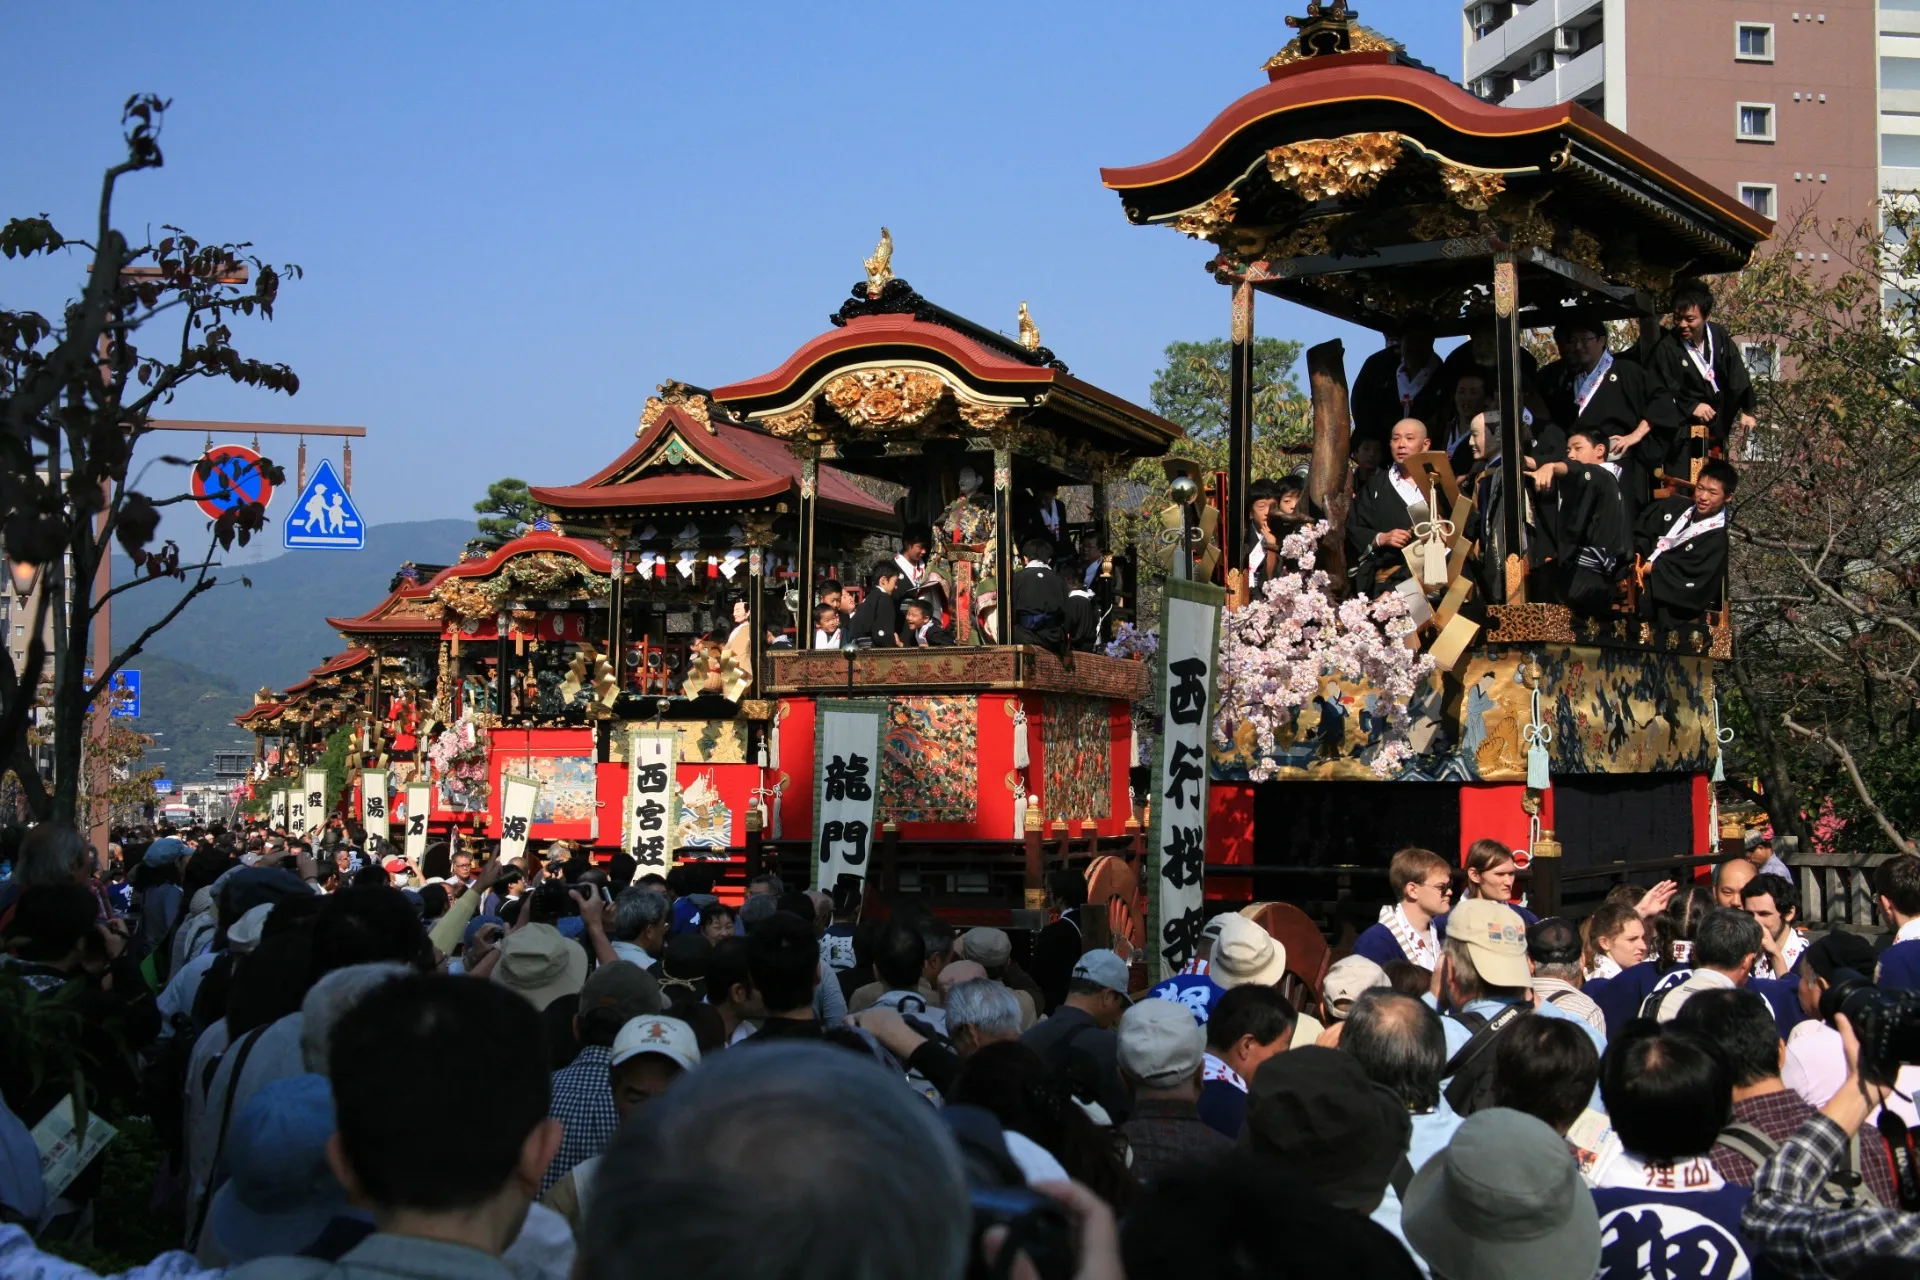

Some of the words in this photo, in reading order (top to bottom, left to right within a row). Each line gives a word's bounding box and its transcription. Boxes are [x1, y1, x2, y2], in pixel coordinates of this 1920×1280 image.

[292, 804, 304, 832] 孔明
[632, 762, 667, 867] 西宮蛭
[503, 816, 527, 842] 源
[1490, 1008, 1518, 1033] Canon
